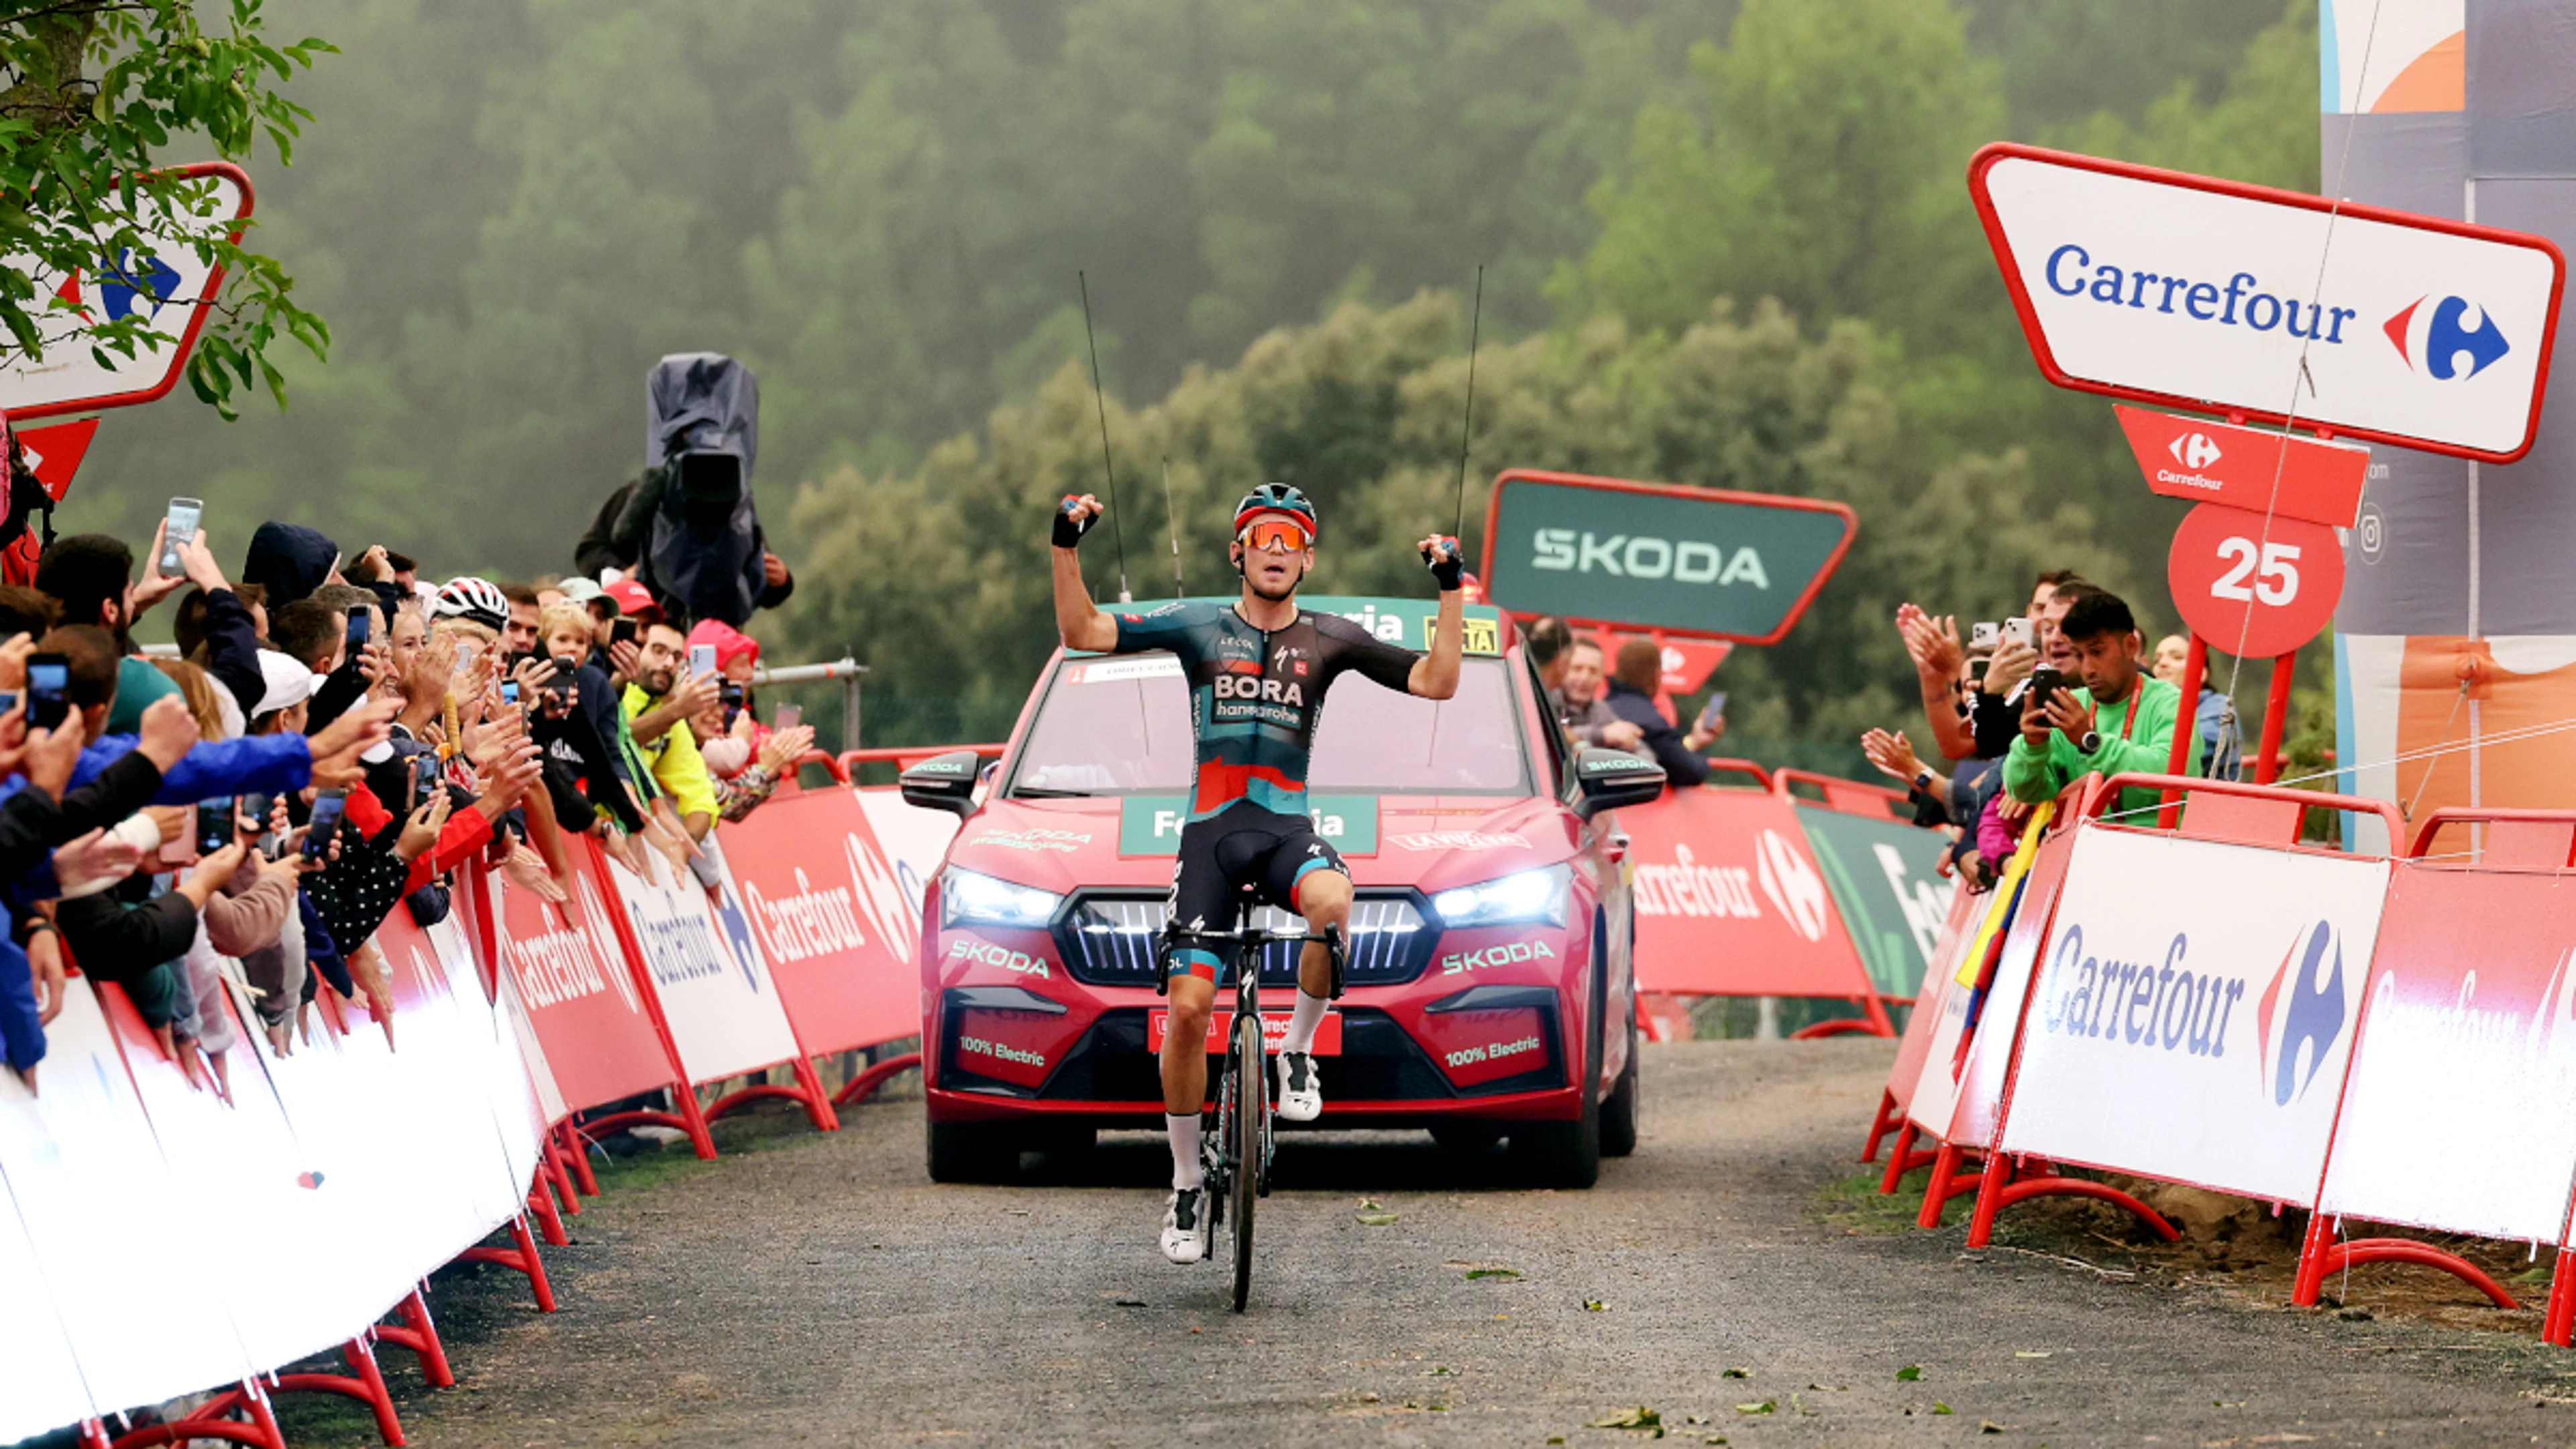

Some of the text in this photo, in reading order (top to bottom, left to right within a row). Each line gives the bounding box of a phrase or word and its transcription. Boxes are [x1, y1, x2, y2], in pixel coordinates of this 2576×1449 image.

[2045, 244, 2355, 345] Carrefour
[2157, 469, 2223, 490] Carrefour
[2210, 537, 2302, 606] 25
[1214, 675, 1303, 707] BORA
[744, 867, 866, 964] Carrefour
[1635, 843, 1760, 918] arrefour
[631, 890, 722, 986] Carrefour
[2042, 922, 2245, 1059] Carrefour
[959, 1036, 1045, 1067] 100% Electric
[1445, 1036, 1540, 1067] 100% Electric
